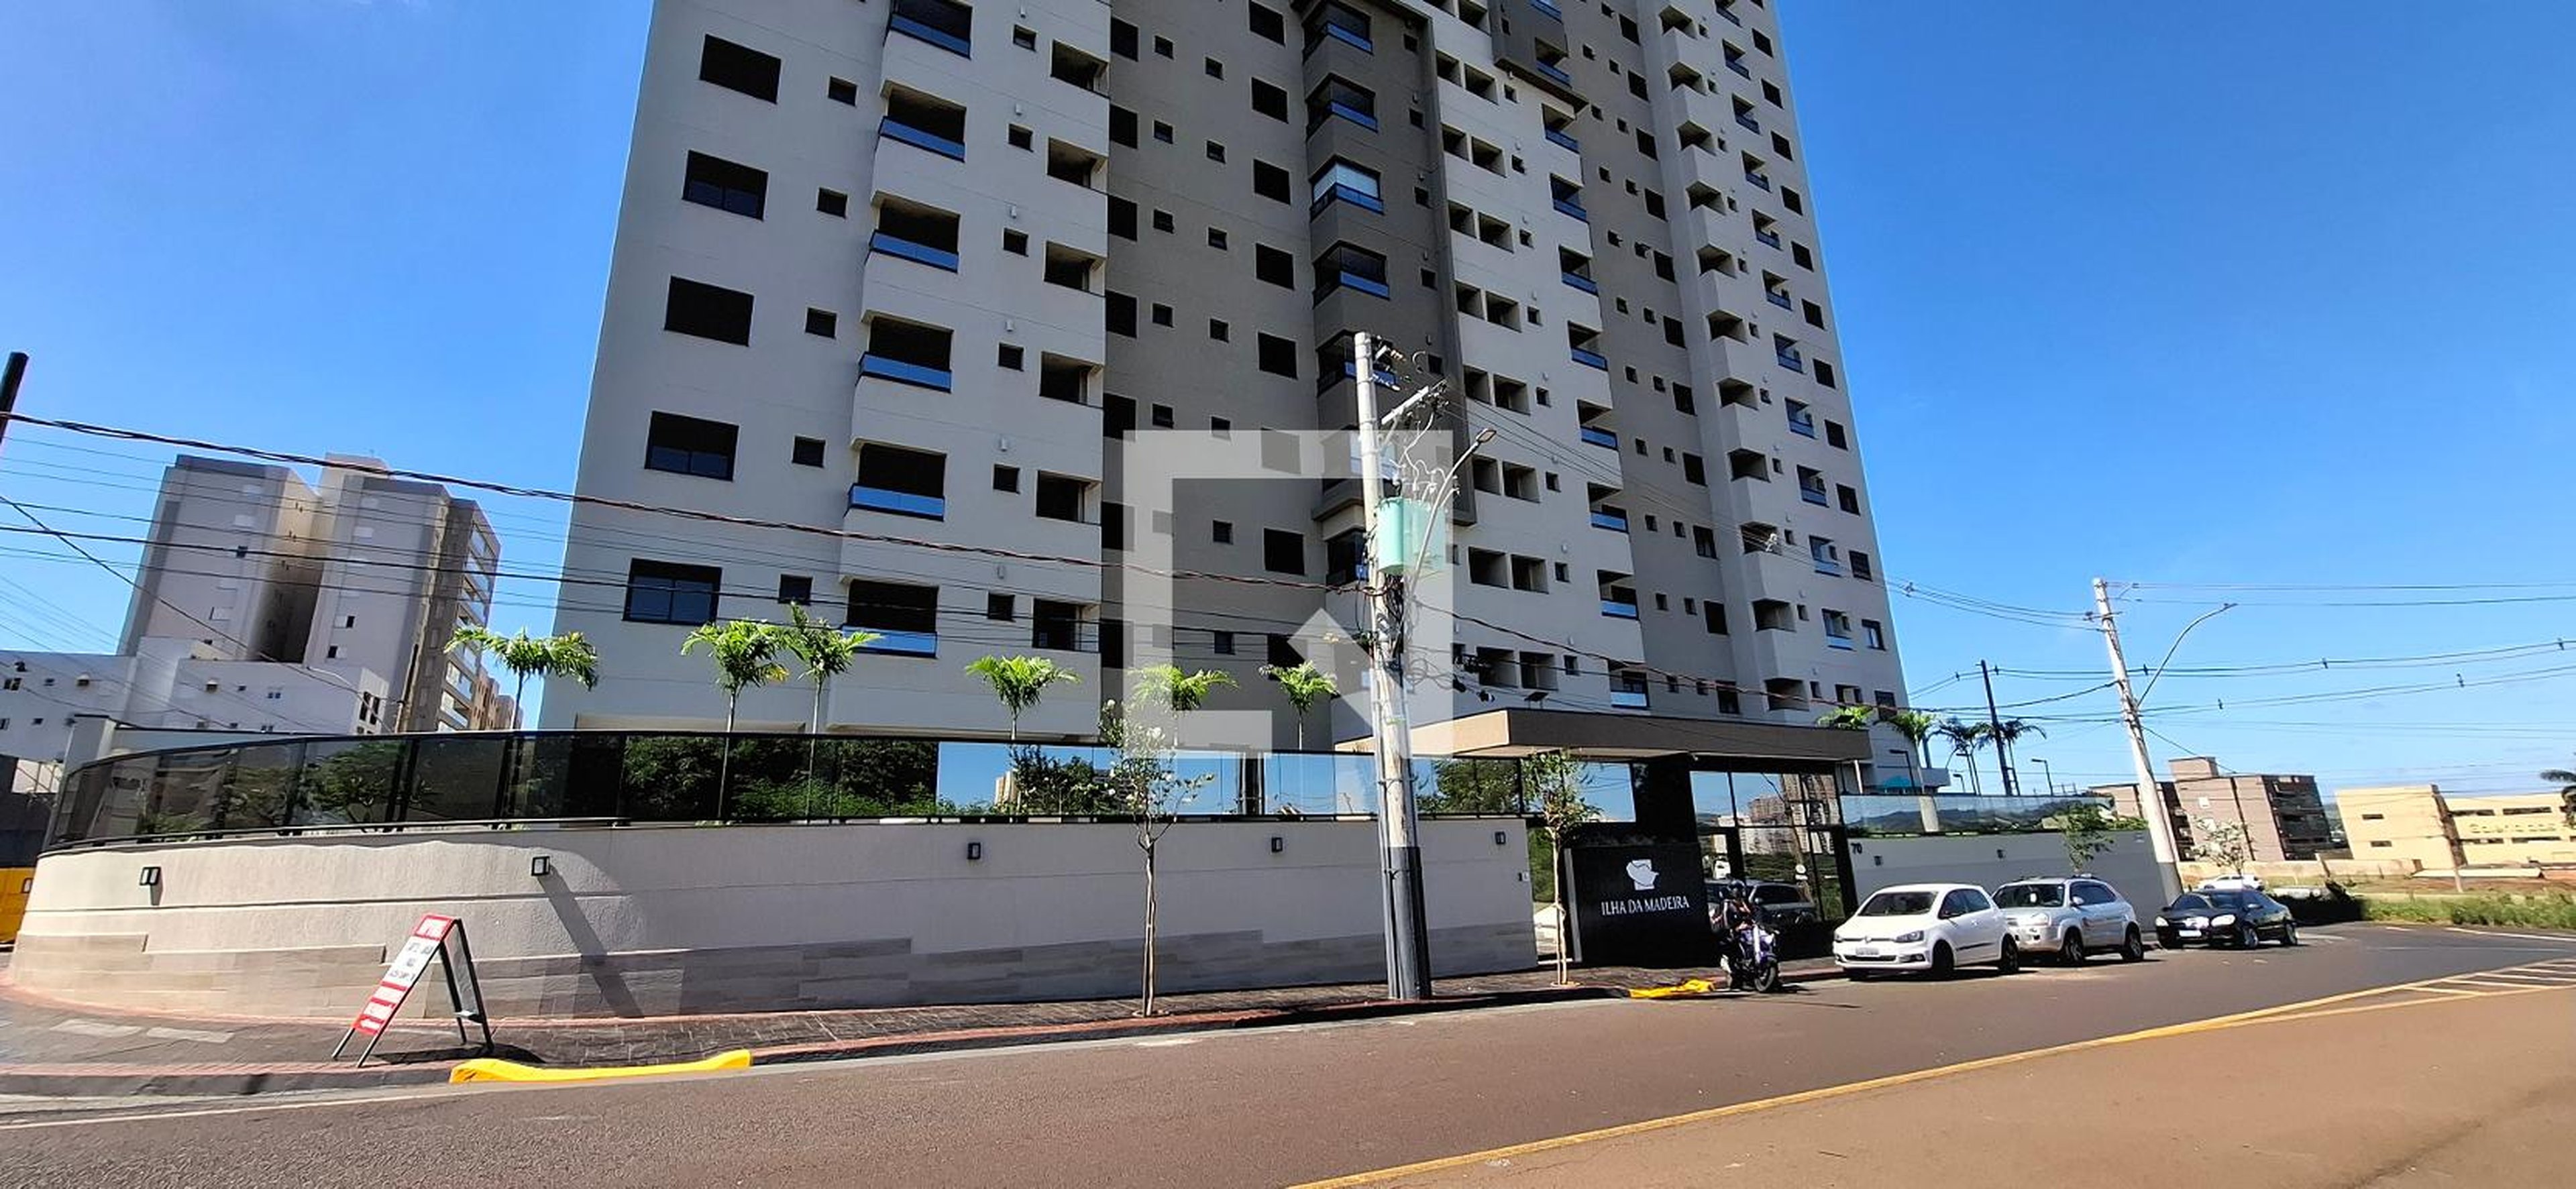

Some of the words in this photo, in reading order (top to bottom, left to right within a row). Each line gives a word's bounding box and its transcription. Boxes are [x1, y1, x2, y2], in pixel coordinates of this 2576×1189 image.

[1851, 842, 1862, 854] 70
[1601, 901, 1627, 915] ILHA
[1627, 899, 1643, 913] DA
[1644, 895, 1690, 912] MADEIRA
